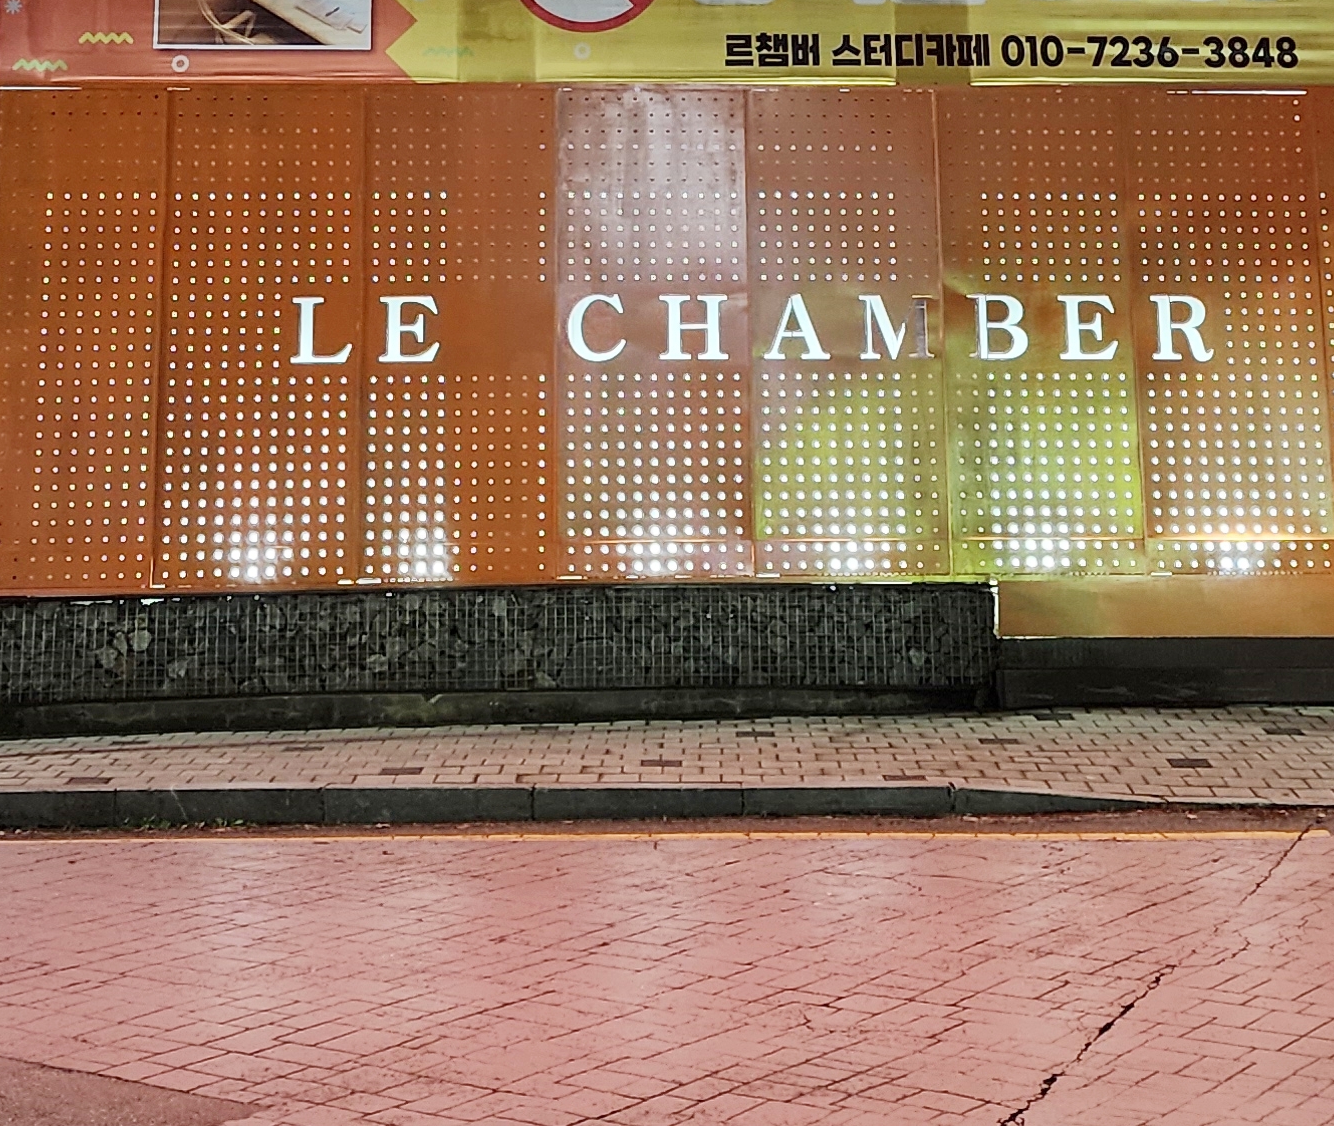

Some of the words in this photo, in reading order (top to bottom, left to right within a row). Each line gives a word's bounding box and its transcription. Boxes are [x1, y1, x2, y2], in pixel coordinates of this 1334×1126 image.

[724, 32, 821, 68] 르챔버
[832, 32, 991, 68] 스터디카페
[1001, 34, 1299, 70] 010-7236-3848
[289, 294, 442, 366] LE
[565, 293, 1214, 364] CHAMBER
